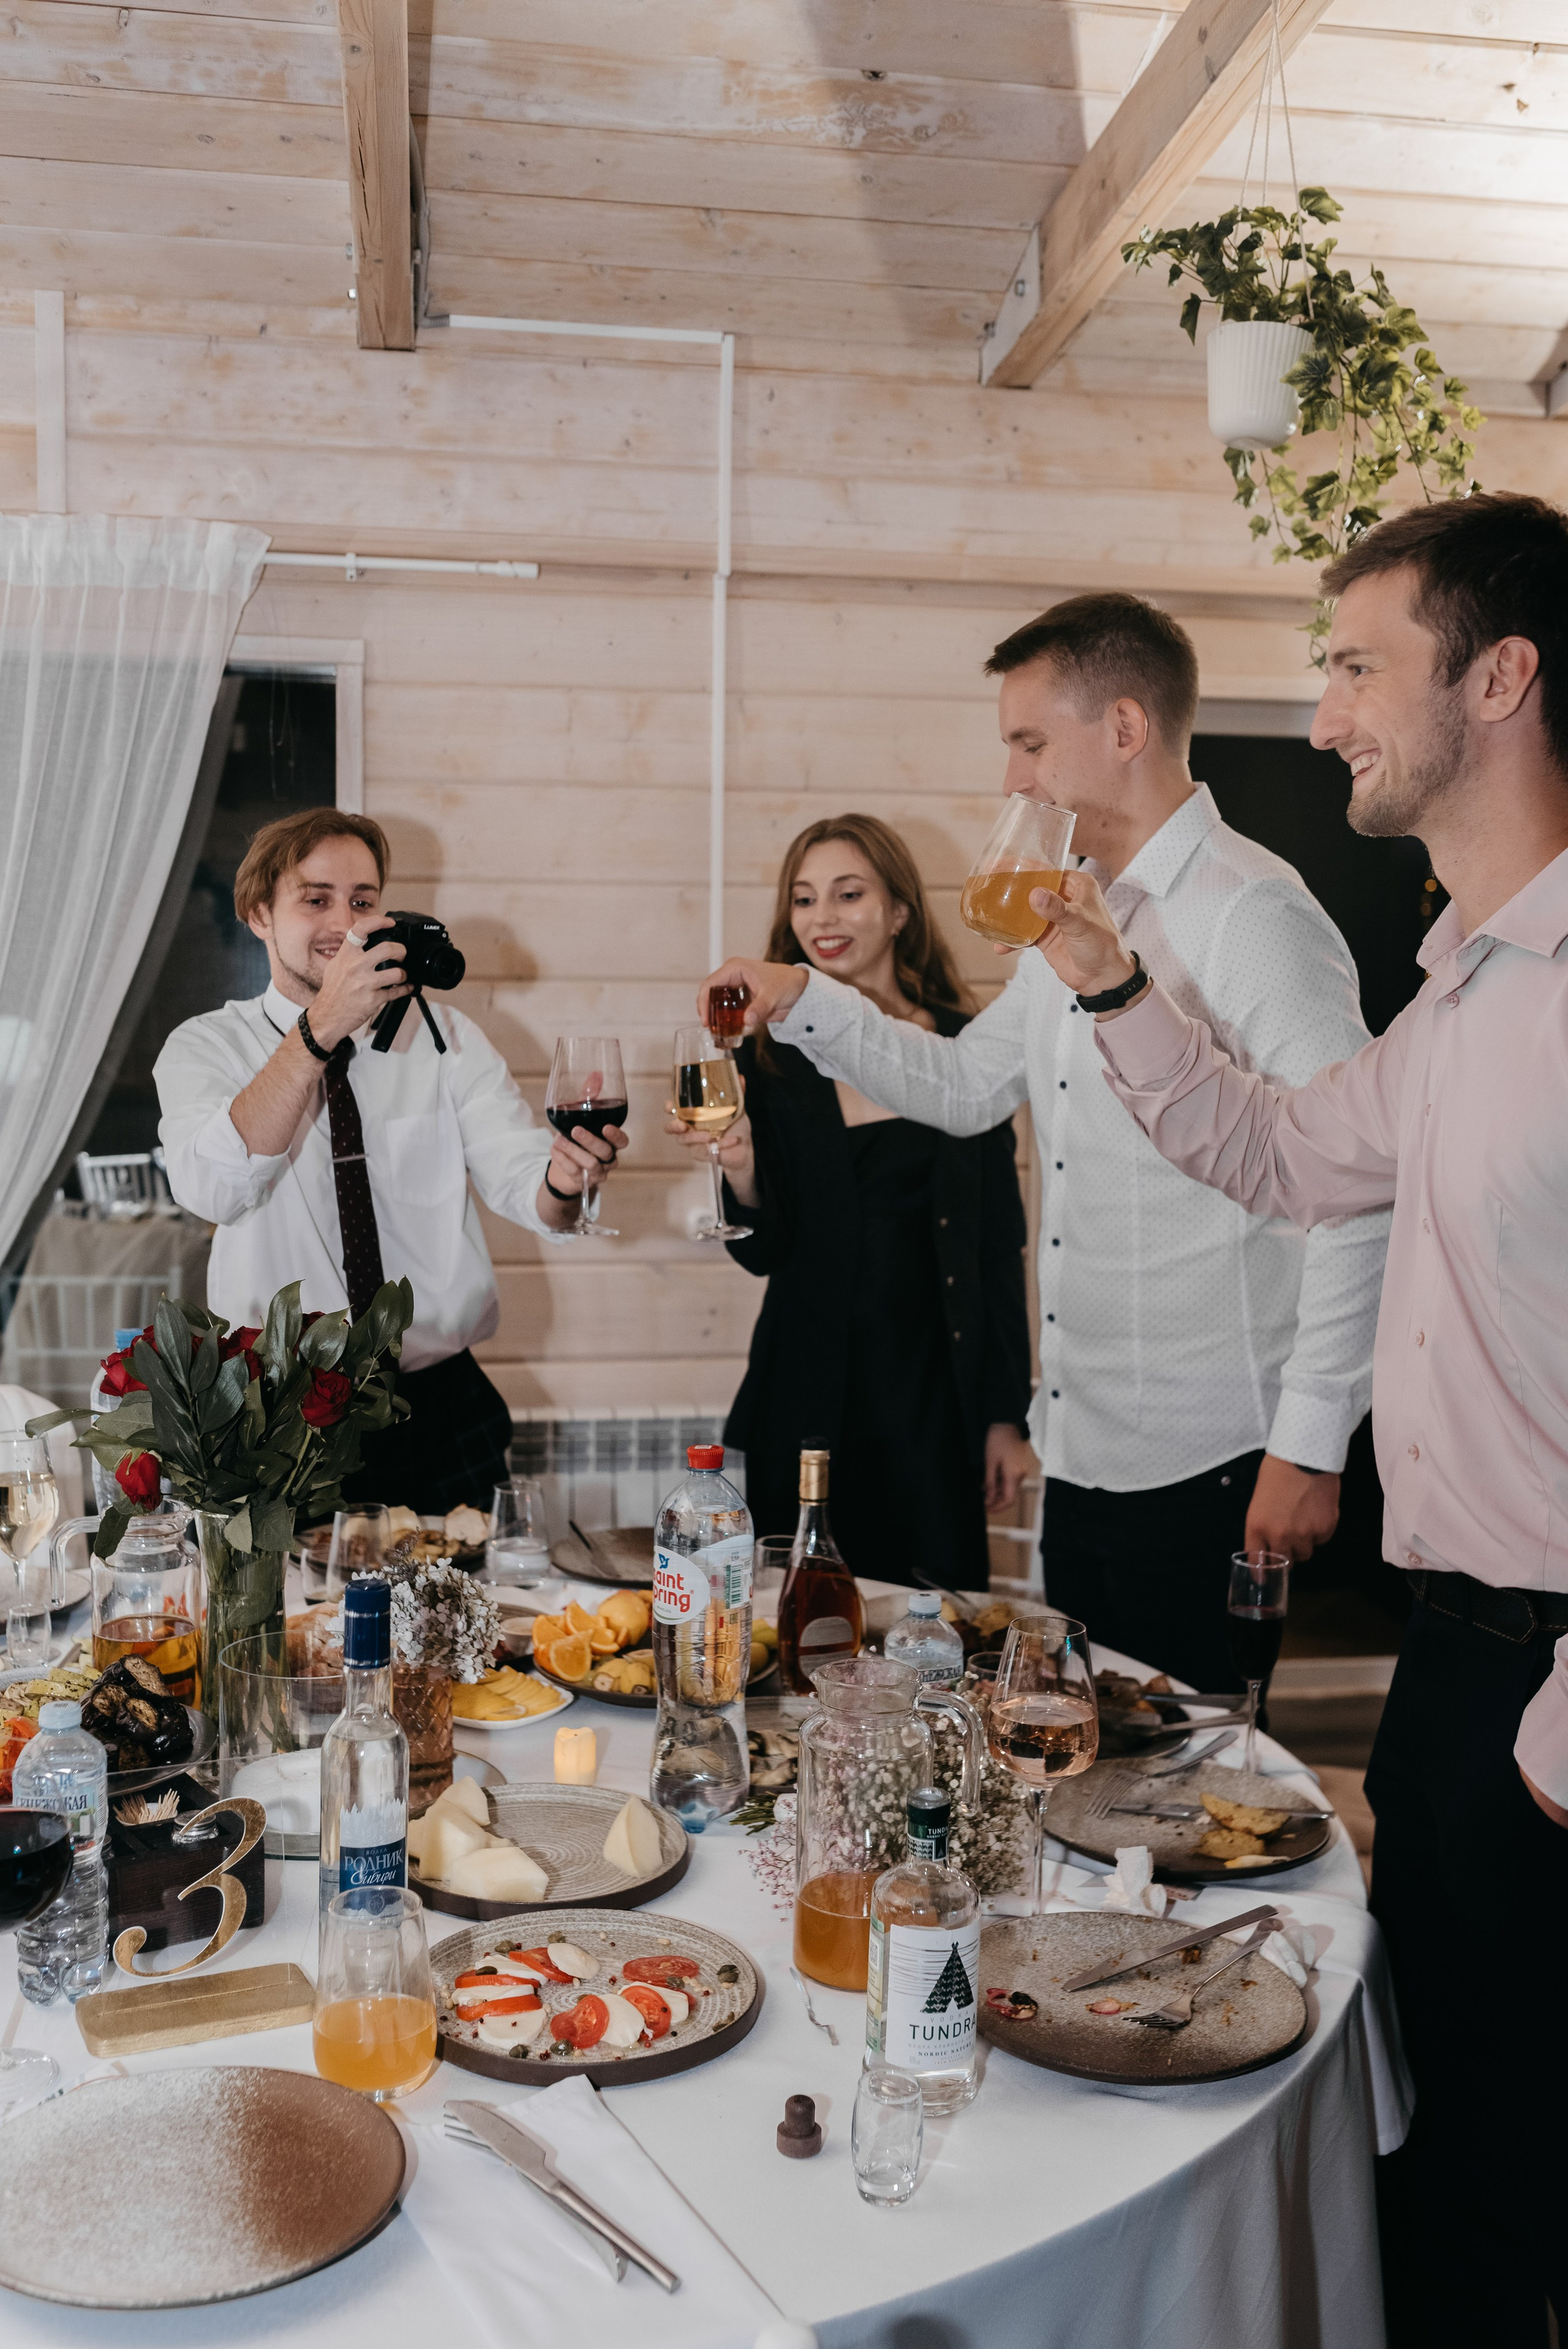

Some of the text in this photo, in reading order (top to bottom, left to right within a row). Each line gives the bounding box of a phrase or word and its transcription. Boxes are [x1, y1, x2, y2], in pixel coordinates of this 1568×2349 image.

[928, 1825, 948, 1834] TUNDR
[344, 1848, 404, 1872] РОДНИК
[350, 1869, 396, 1885] Сибири
[113, 1797, 268, 1979] 3
[930, 2010, 969, 2023] VODKA
[909, 2013, 976, 2040] TUNDRA
[951, 2042, 971, 2054] NATURE
